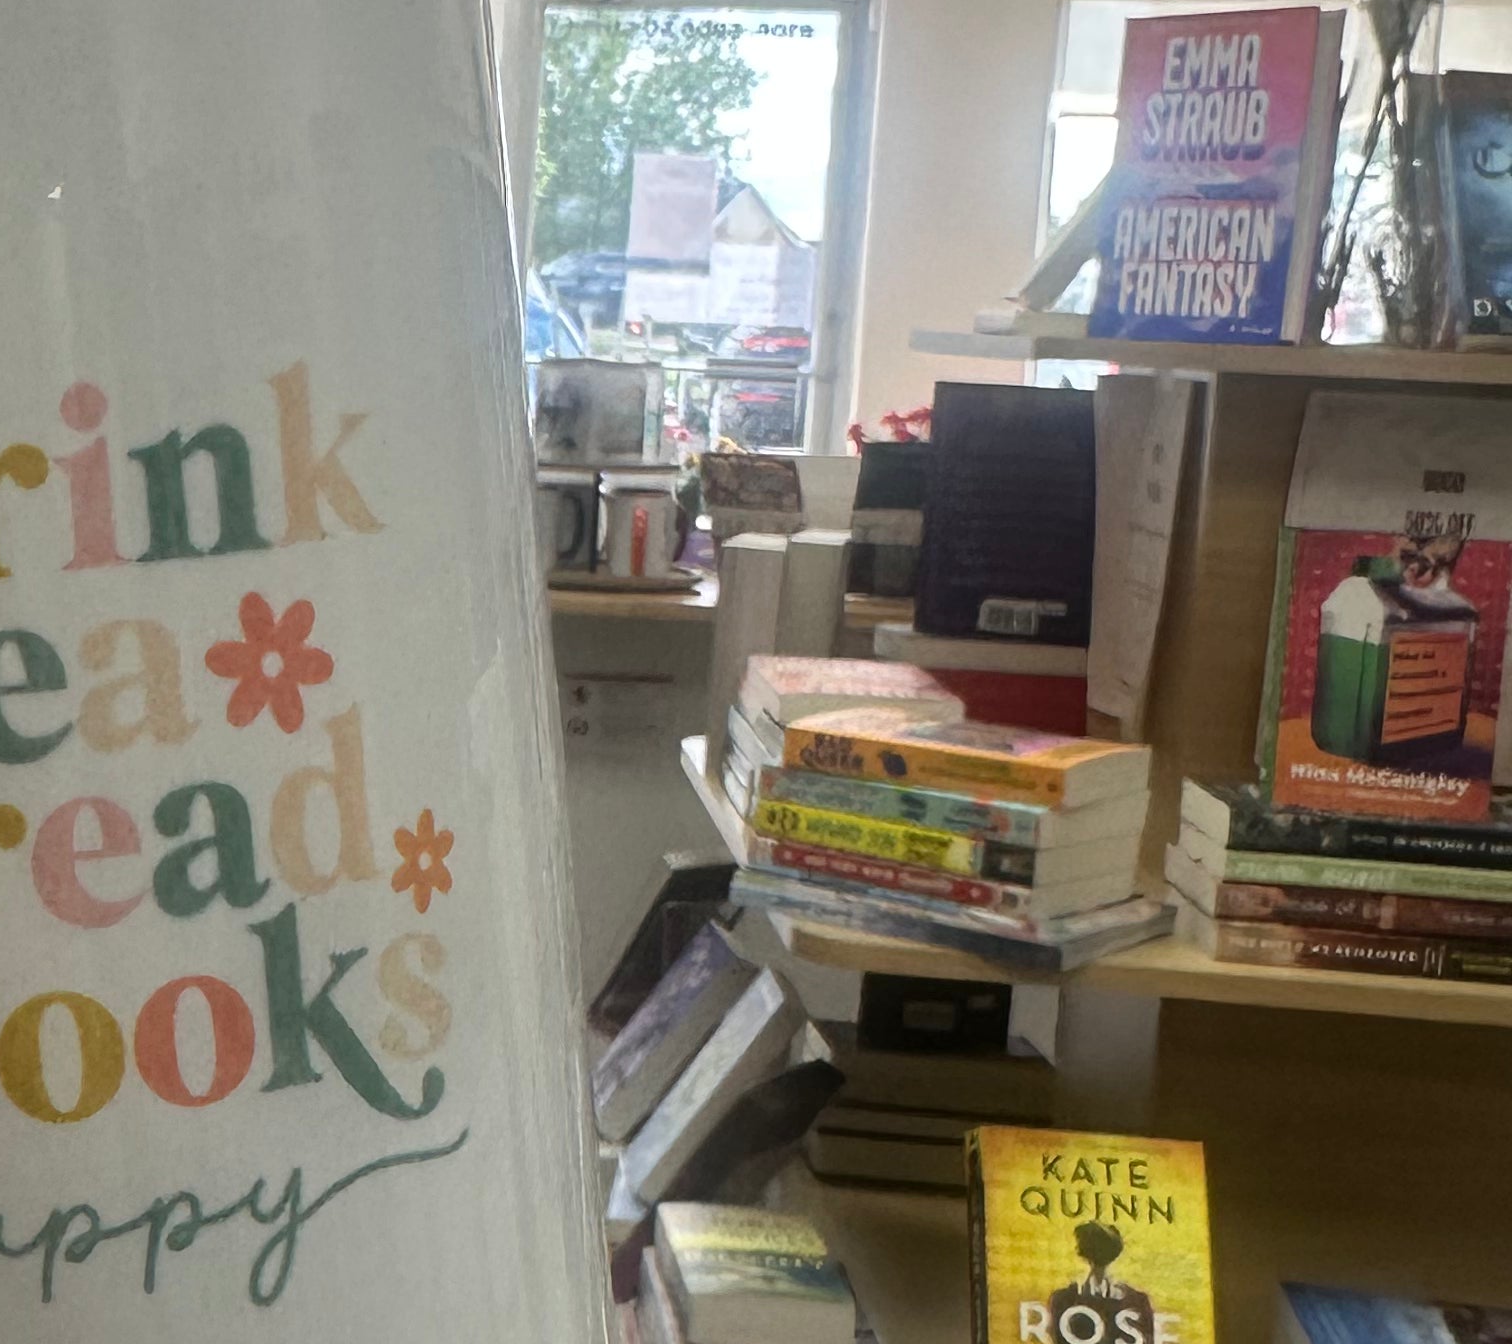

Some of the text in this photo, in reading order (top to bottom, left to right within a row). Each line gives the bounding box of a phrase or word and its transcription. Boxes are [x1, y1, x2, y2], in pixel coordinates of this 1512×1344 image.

[1164, 35, 1260, 90] EMMA
[1144, 90, 1270, 148] STRAUB
[1113, 205, 1276, 262] AMERICAN
[1118, 262, 1259, 318] FANTASY
[1041, 1153, 1149, 1190] KATE
[1019, 1186, 1176, 1225] QUINN
[1076, 1277, 1125, 1300] THE
